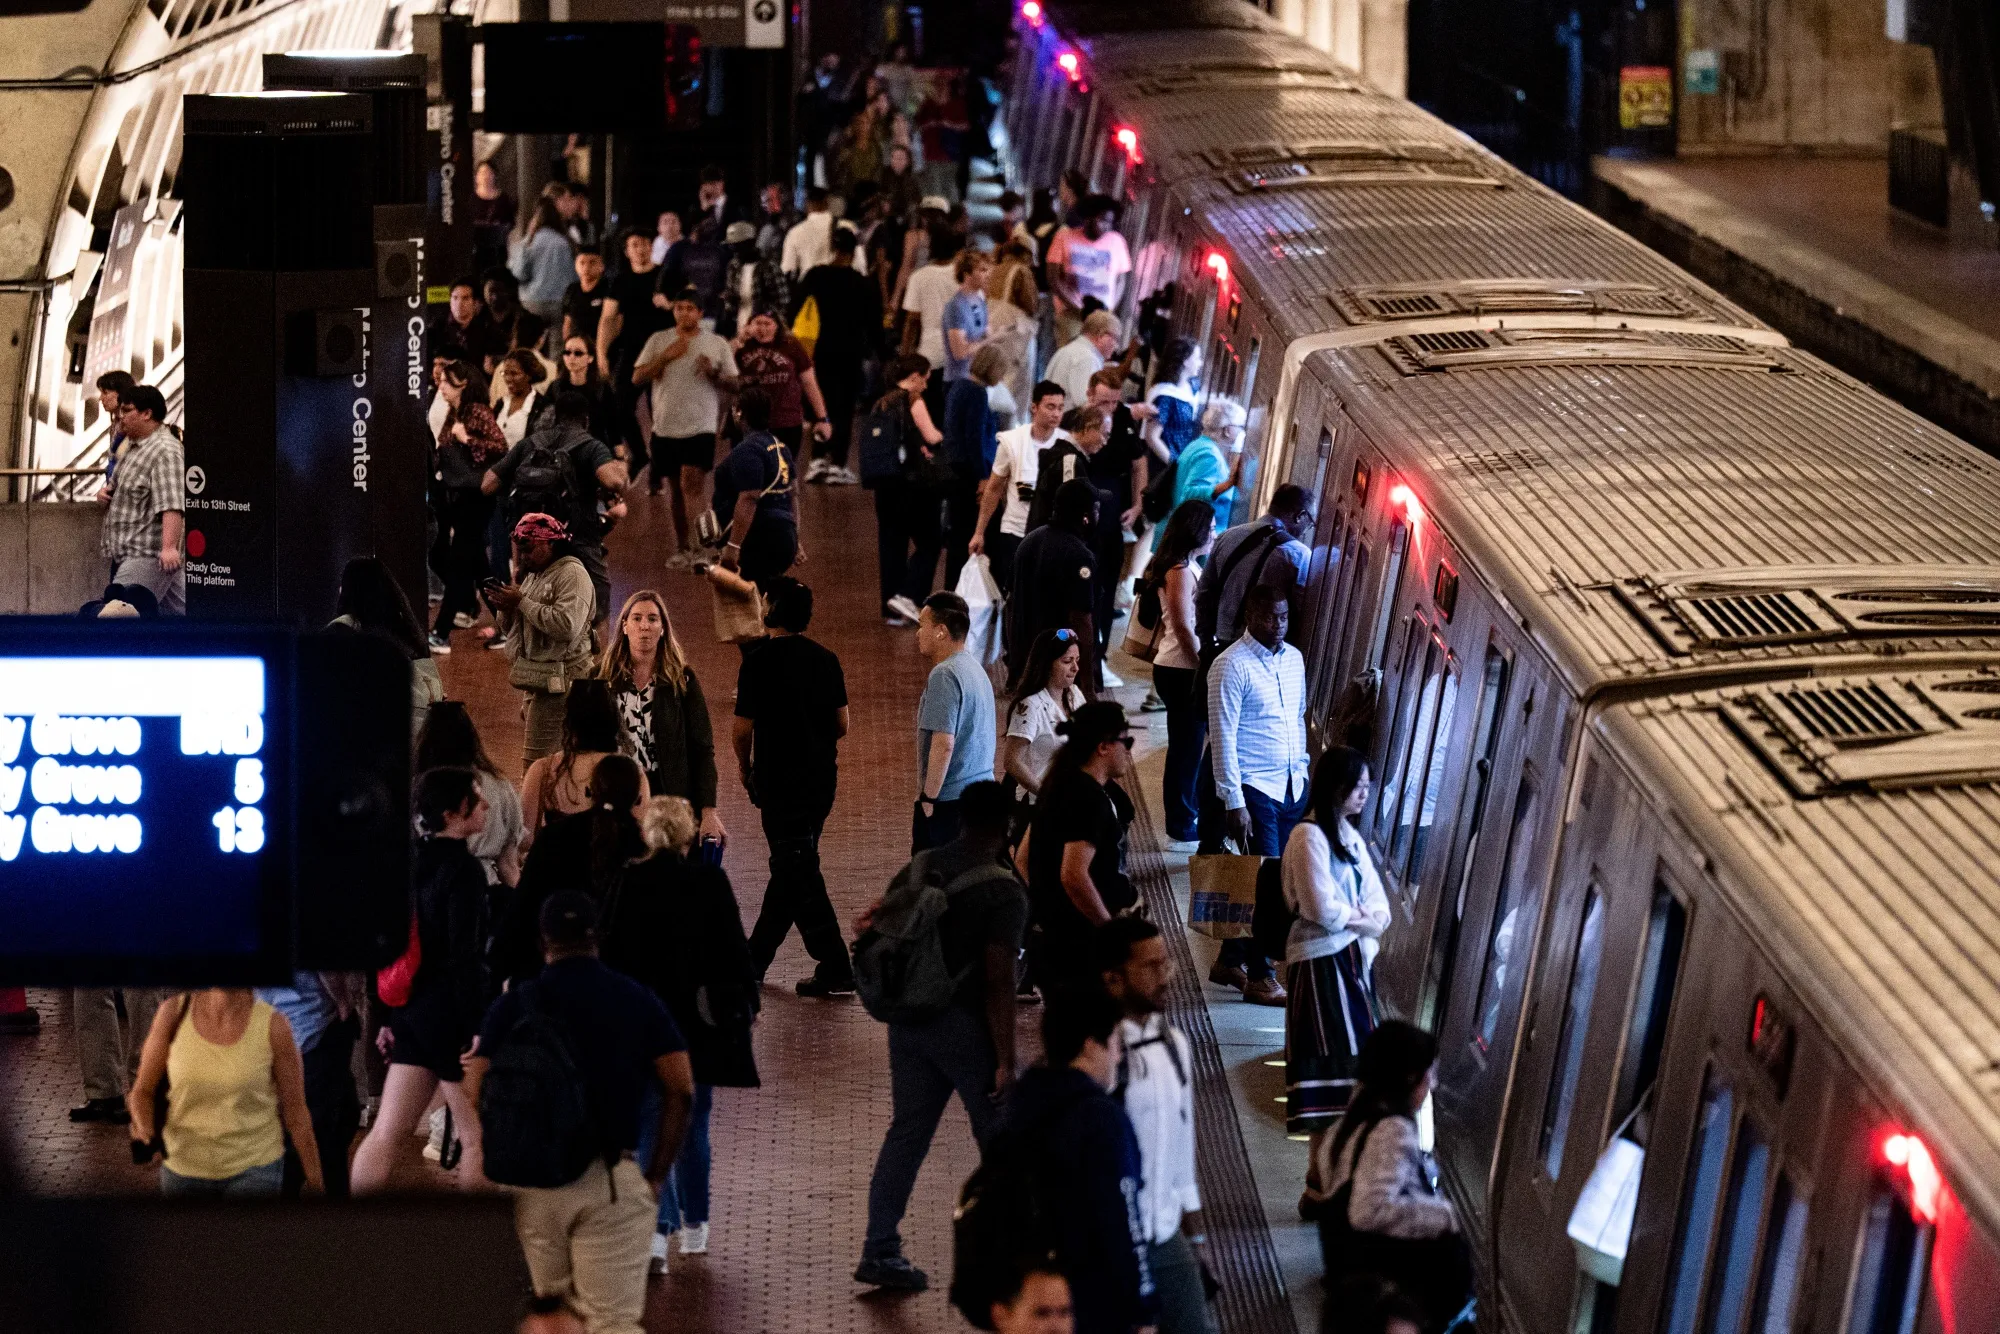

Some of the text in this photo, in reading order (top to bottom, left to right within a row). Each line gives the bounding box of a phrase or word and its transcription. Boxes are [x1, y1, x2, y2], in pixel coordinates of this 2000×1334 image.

[440, 162, 455, 226] Center
[408, 316, 425, 399] Center
[353, 397, 372, 491] Center
[185, 498, 251, 512] Exit to 13th Street
[186, 561, 231, 574] Shady Grove
[186, 573, 235, 587] This platform
[212, 806, 264, 853] 13
